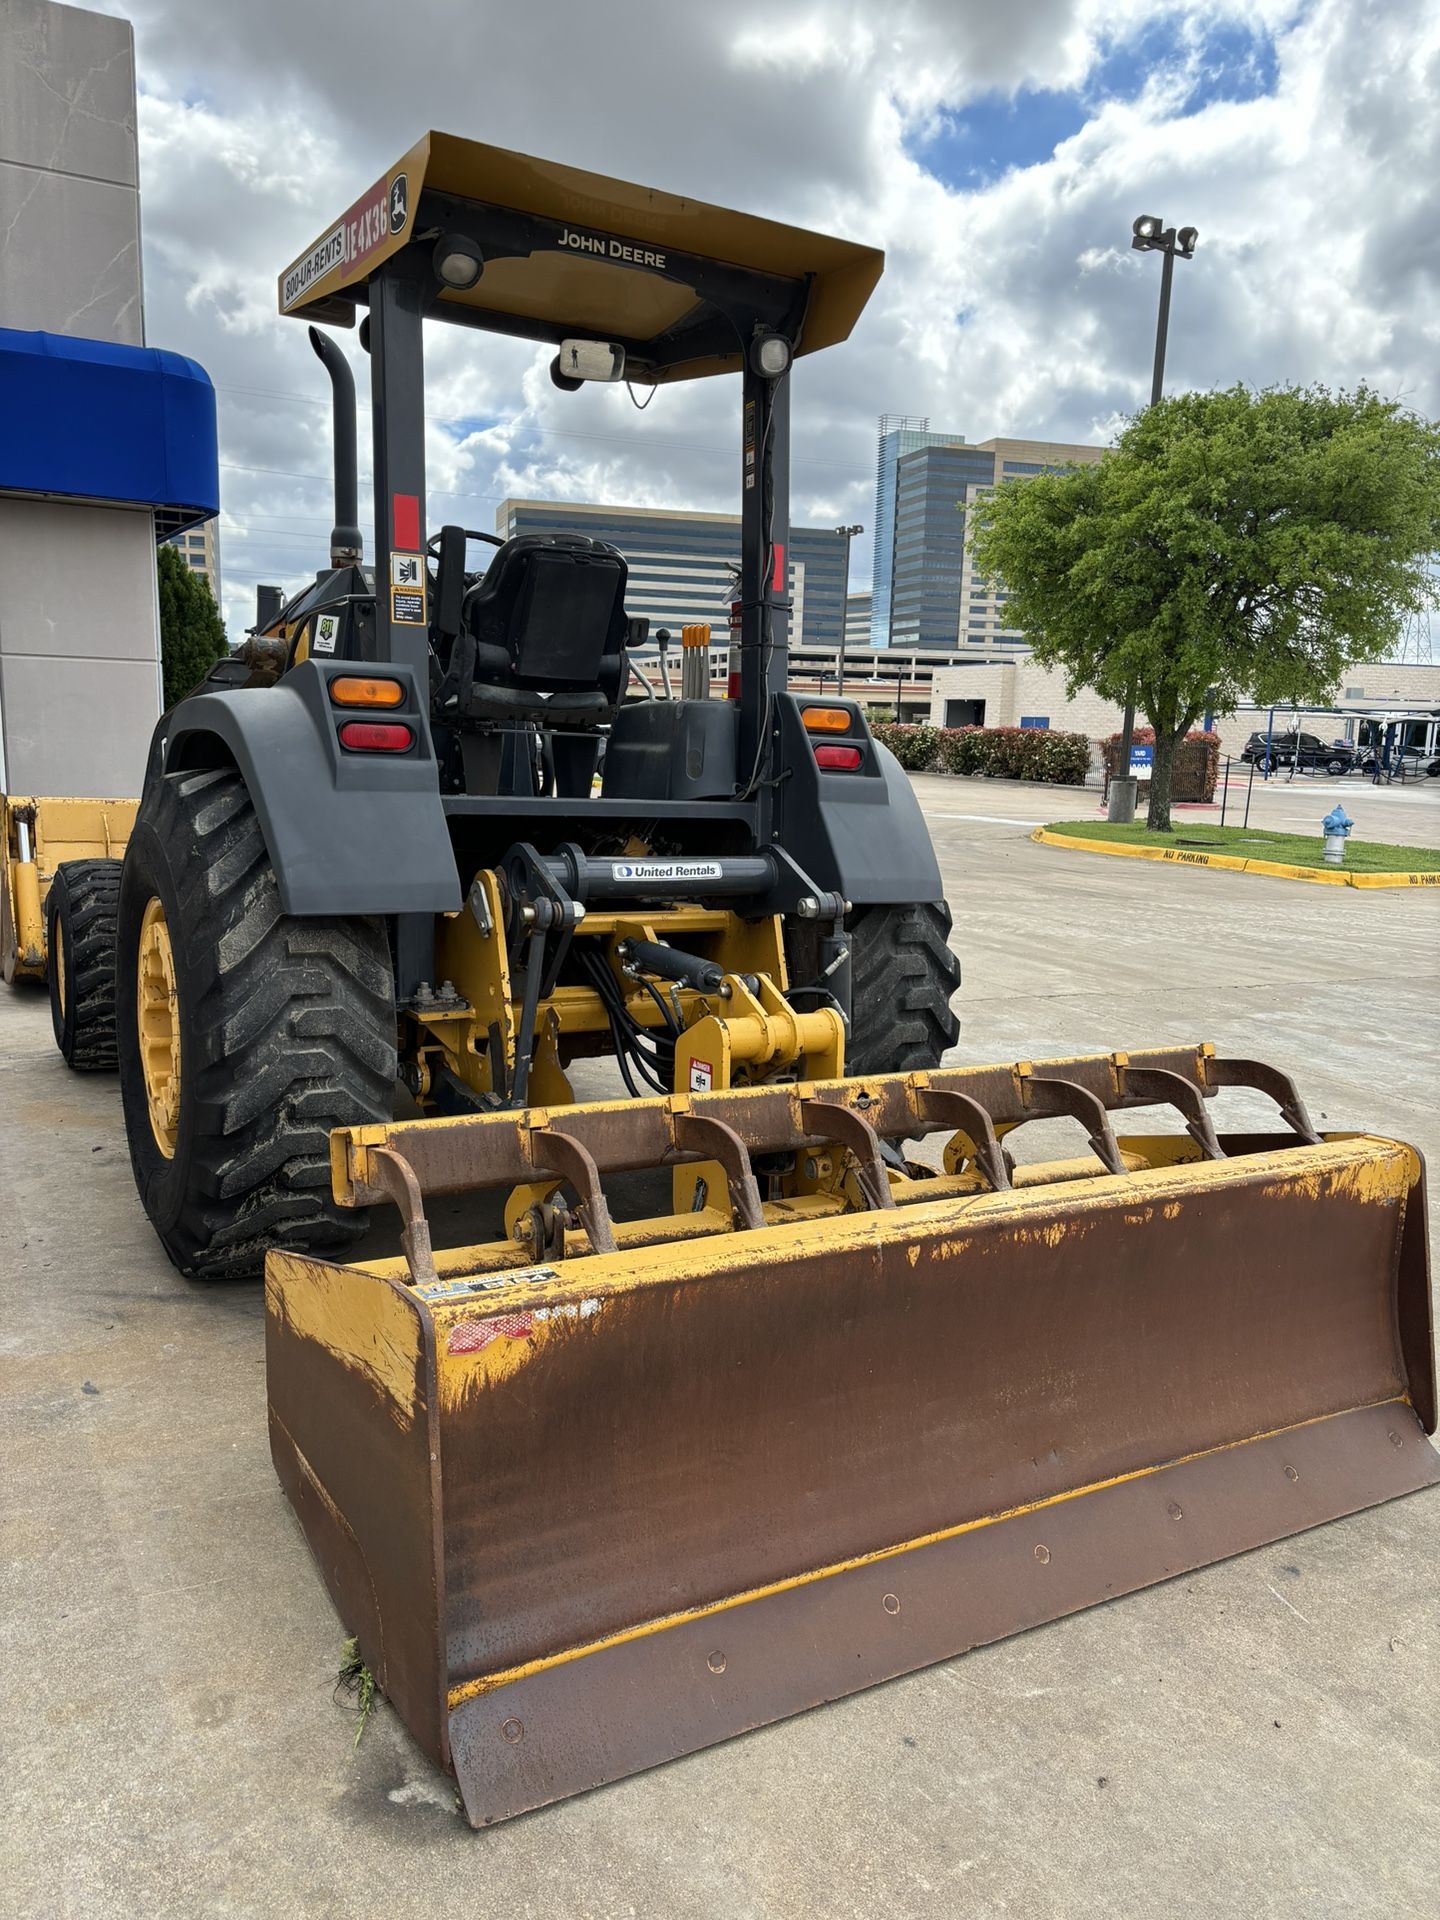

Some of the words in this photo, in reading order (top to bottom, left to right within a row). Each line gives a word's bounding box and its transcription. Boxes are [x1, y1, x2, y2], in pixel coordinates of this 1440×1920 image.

[344, 197, 388, 264] JE4X36
[558, 229, 605, 254] JOHN
[609, 240, 666, 269] DEERE
[285, 231, 342, 301] 800-UR-RENTS
[321, 618, 333, 632] 811
[1163, 850, 1175, 859] NO
[1176, 851, 1210, 865] PARKING
[635, 867, 672, 877] United
[676, 866, 716, 876] Rentals
[1408, 874, 1418, 885] NO
